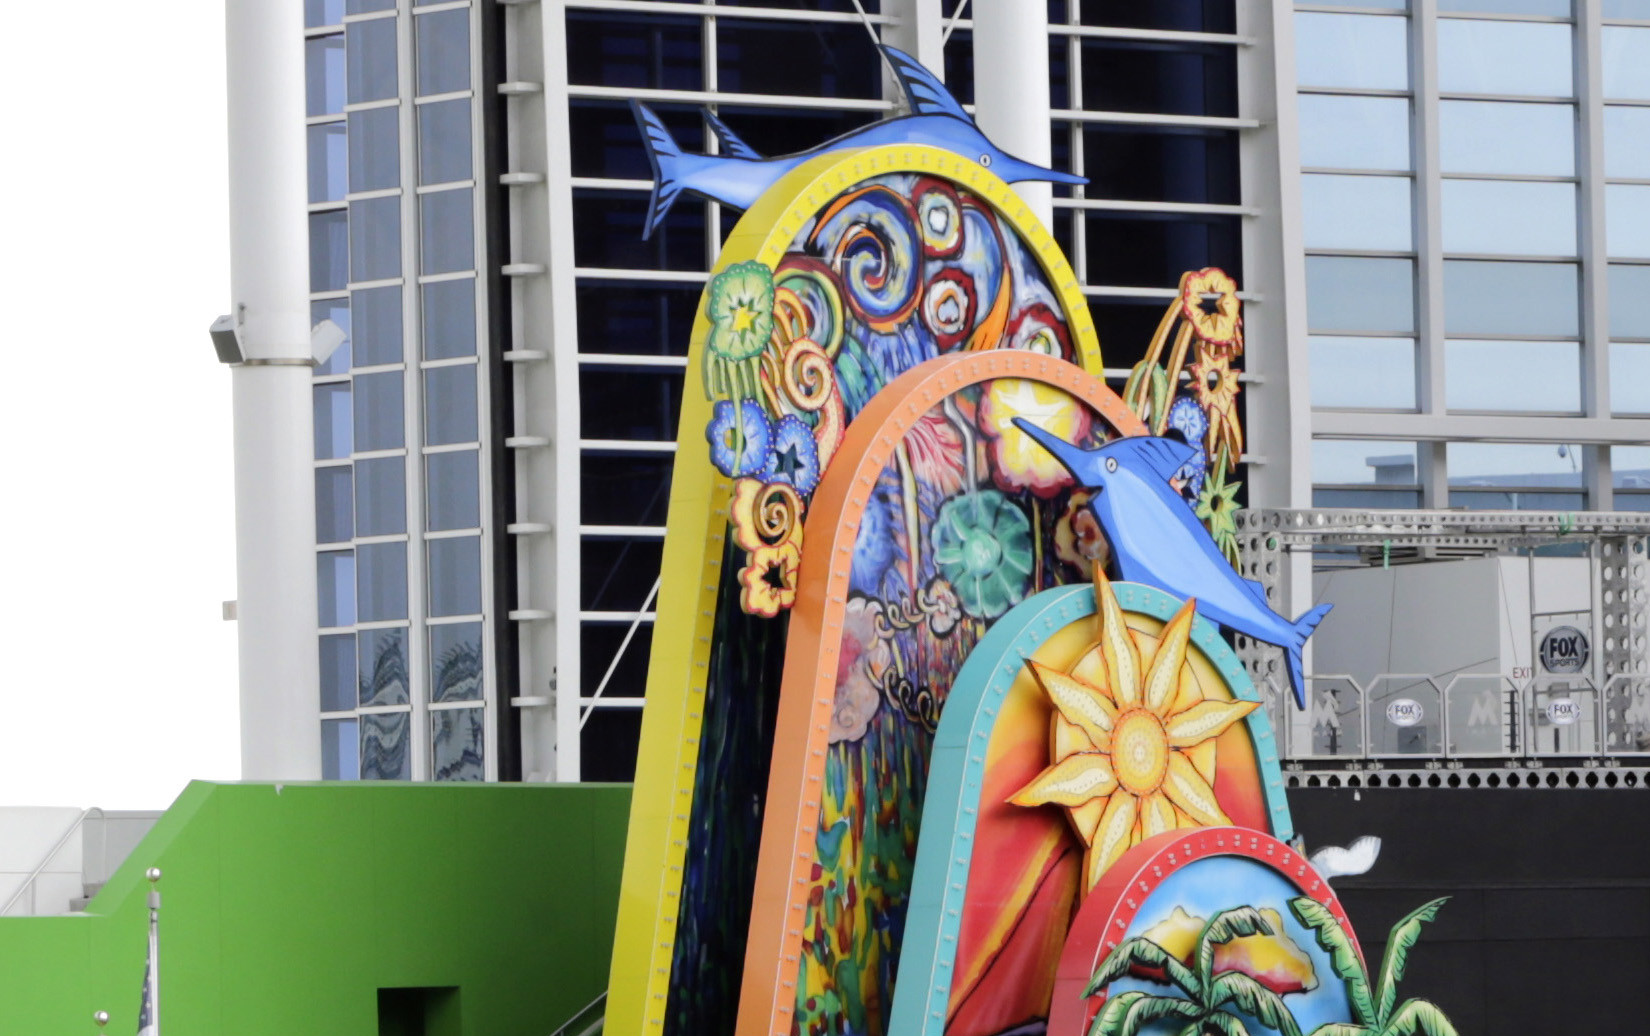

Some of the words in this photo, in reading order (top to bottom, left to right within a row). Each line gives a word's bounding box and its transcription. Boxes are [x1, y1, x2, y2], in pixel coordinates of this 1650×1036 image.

[1550, 636, 1579, 658] FOX
[1394, 704, 1415, 715] FOX
[1553, 704, 1574, 715] FOX
